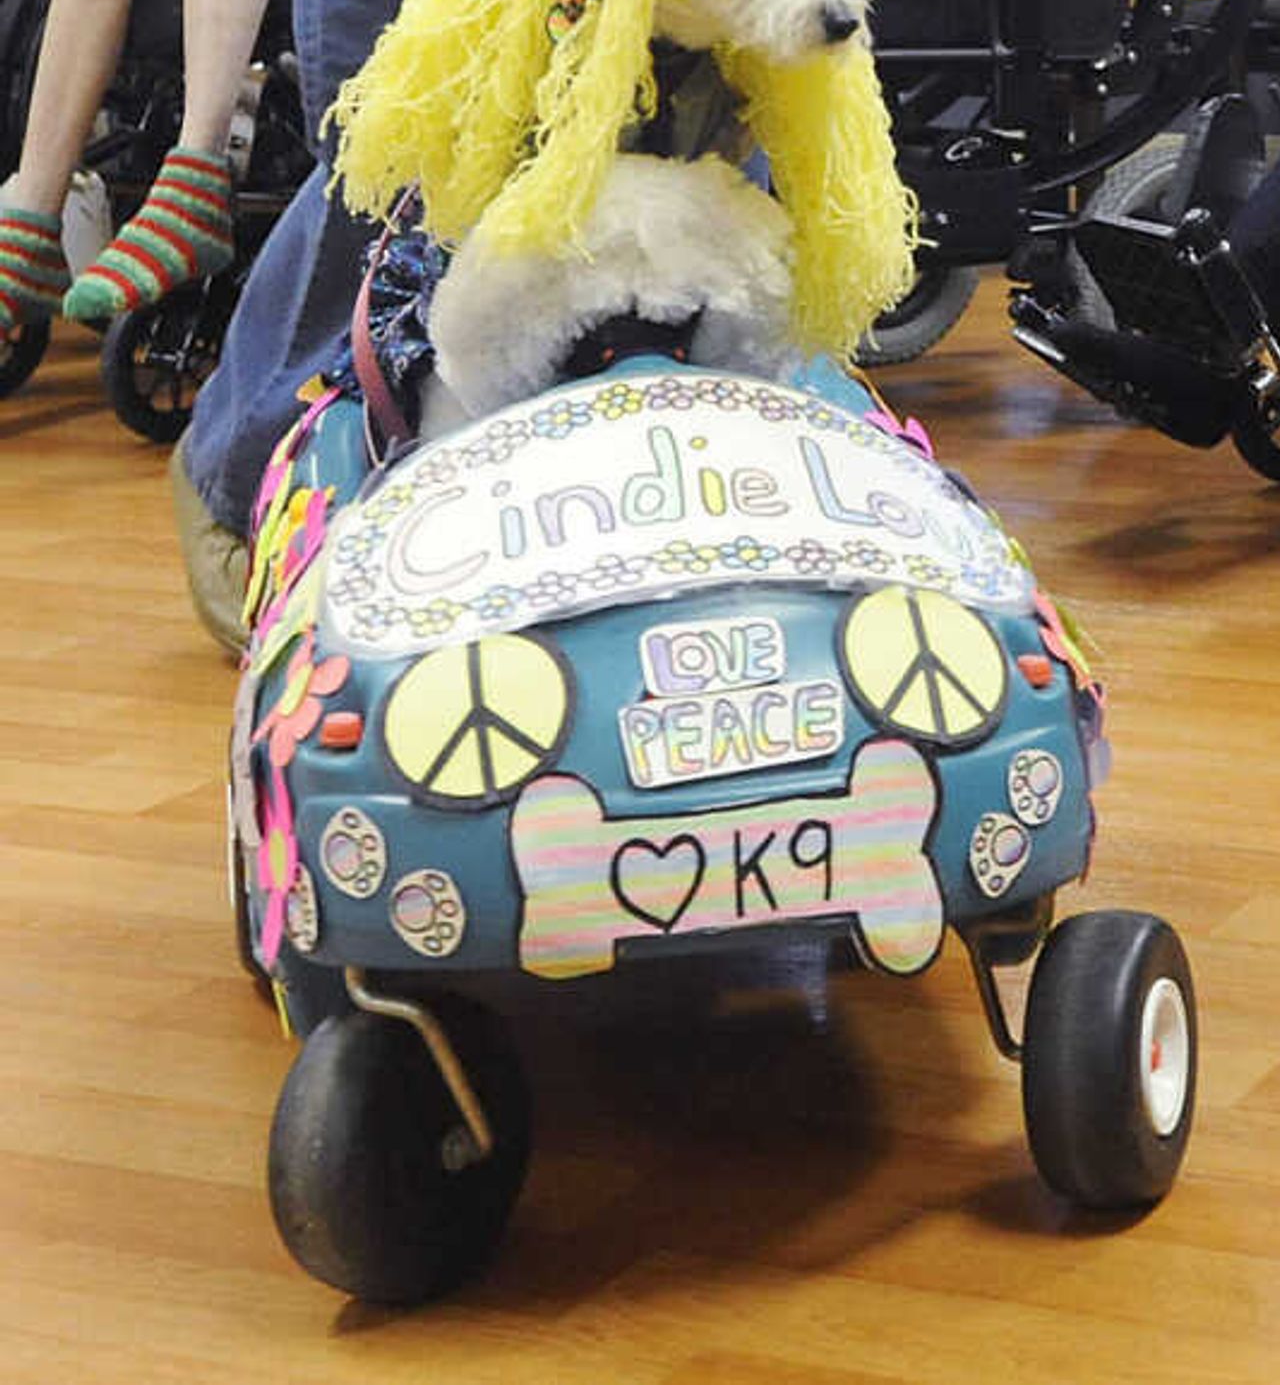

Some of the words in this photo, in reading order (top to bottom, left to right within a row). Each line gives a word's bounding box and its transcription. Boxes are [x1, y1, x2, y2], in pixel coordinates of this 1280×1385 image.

[386, 425, 790, 595] Cindie
[647, 623, 777, 693] LOVE
[623, 683, 838, 785] PEACE
[734, 819, 833, 918] K9
